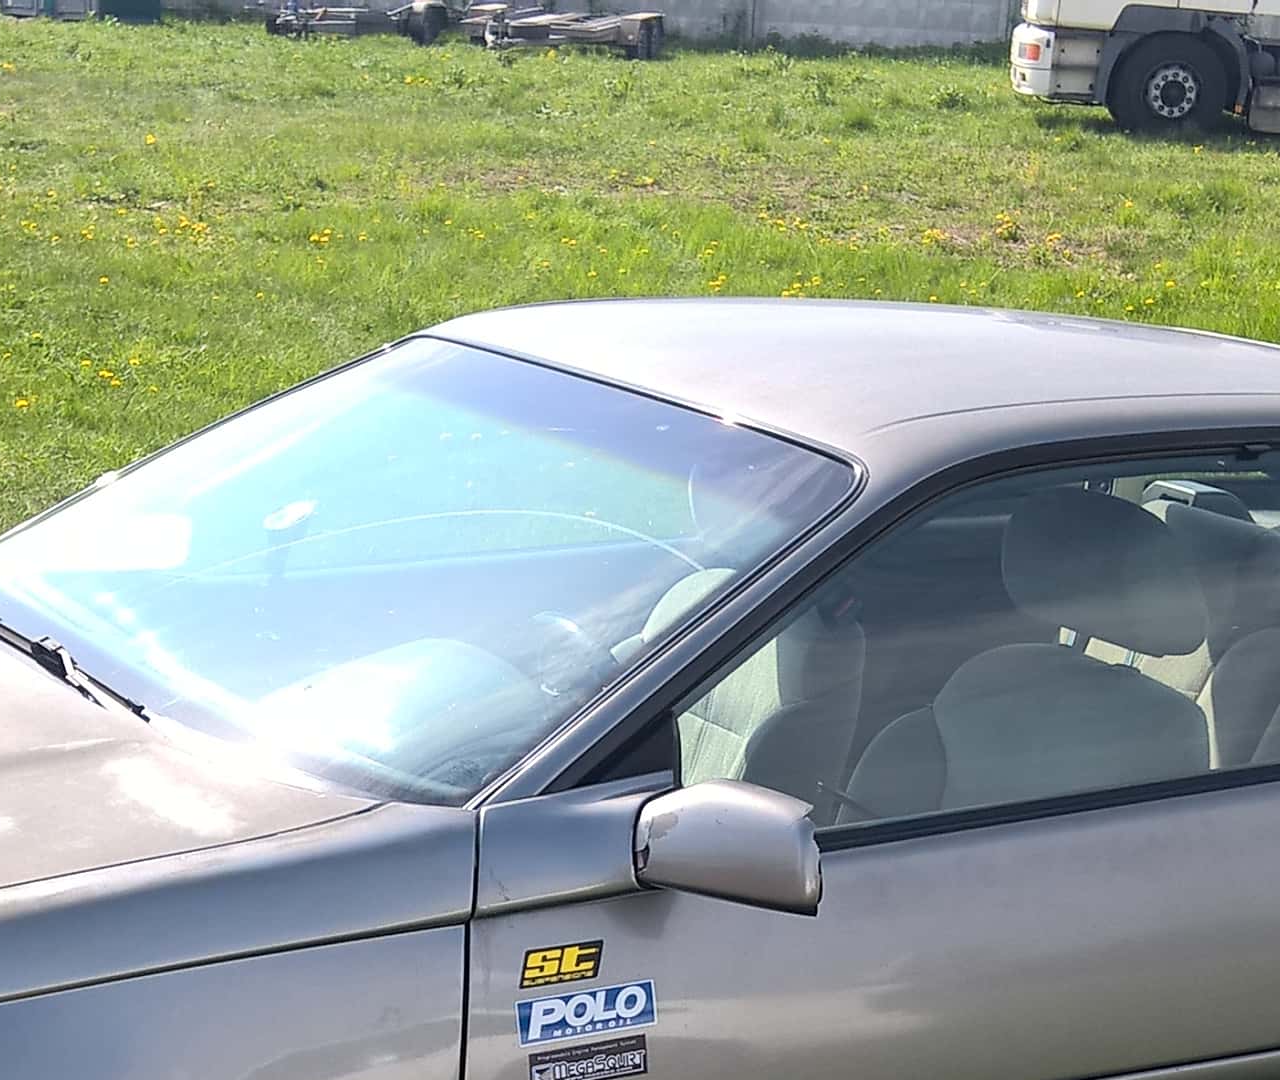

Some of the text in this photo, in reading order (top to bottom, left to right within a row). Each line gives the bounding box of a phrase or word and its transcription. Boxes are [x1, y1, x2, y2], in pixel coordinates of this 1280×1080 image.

[527, 986, 646, 1040] POLO
[552, 1018, 633, 1037] MOTOR OIL
